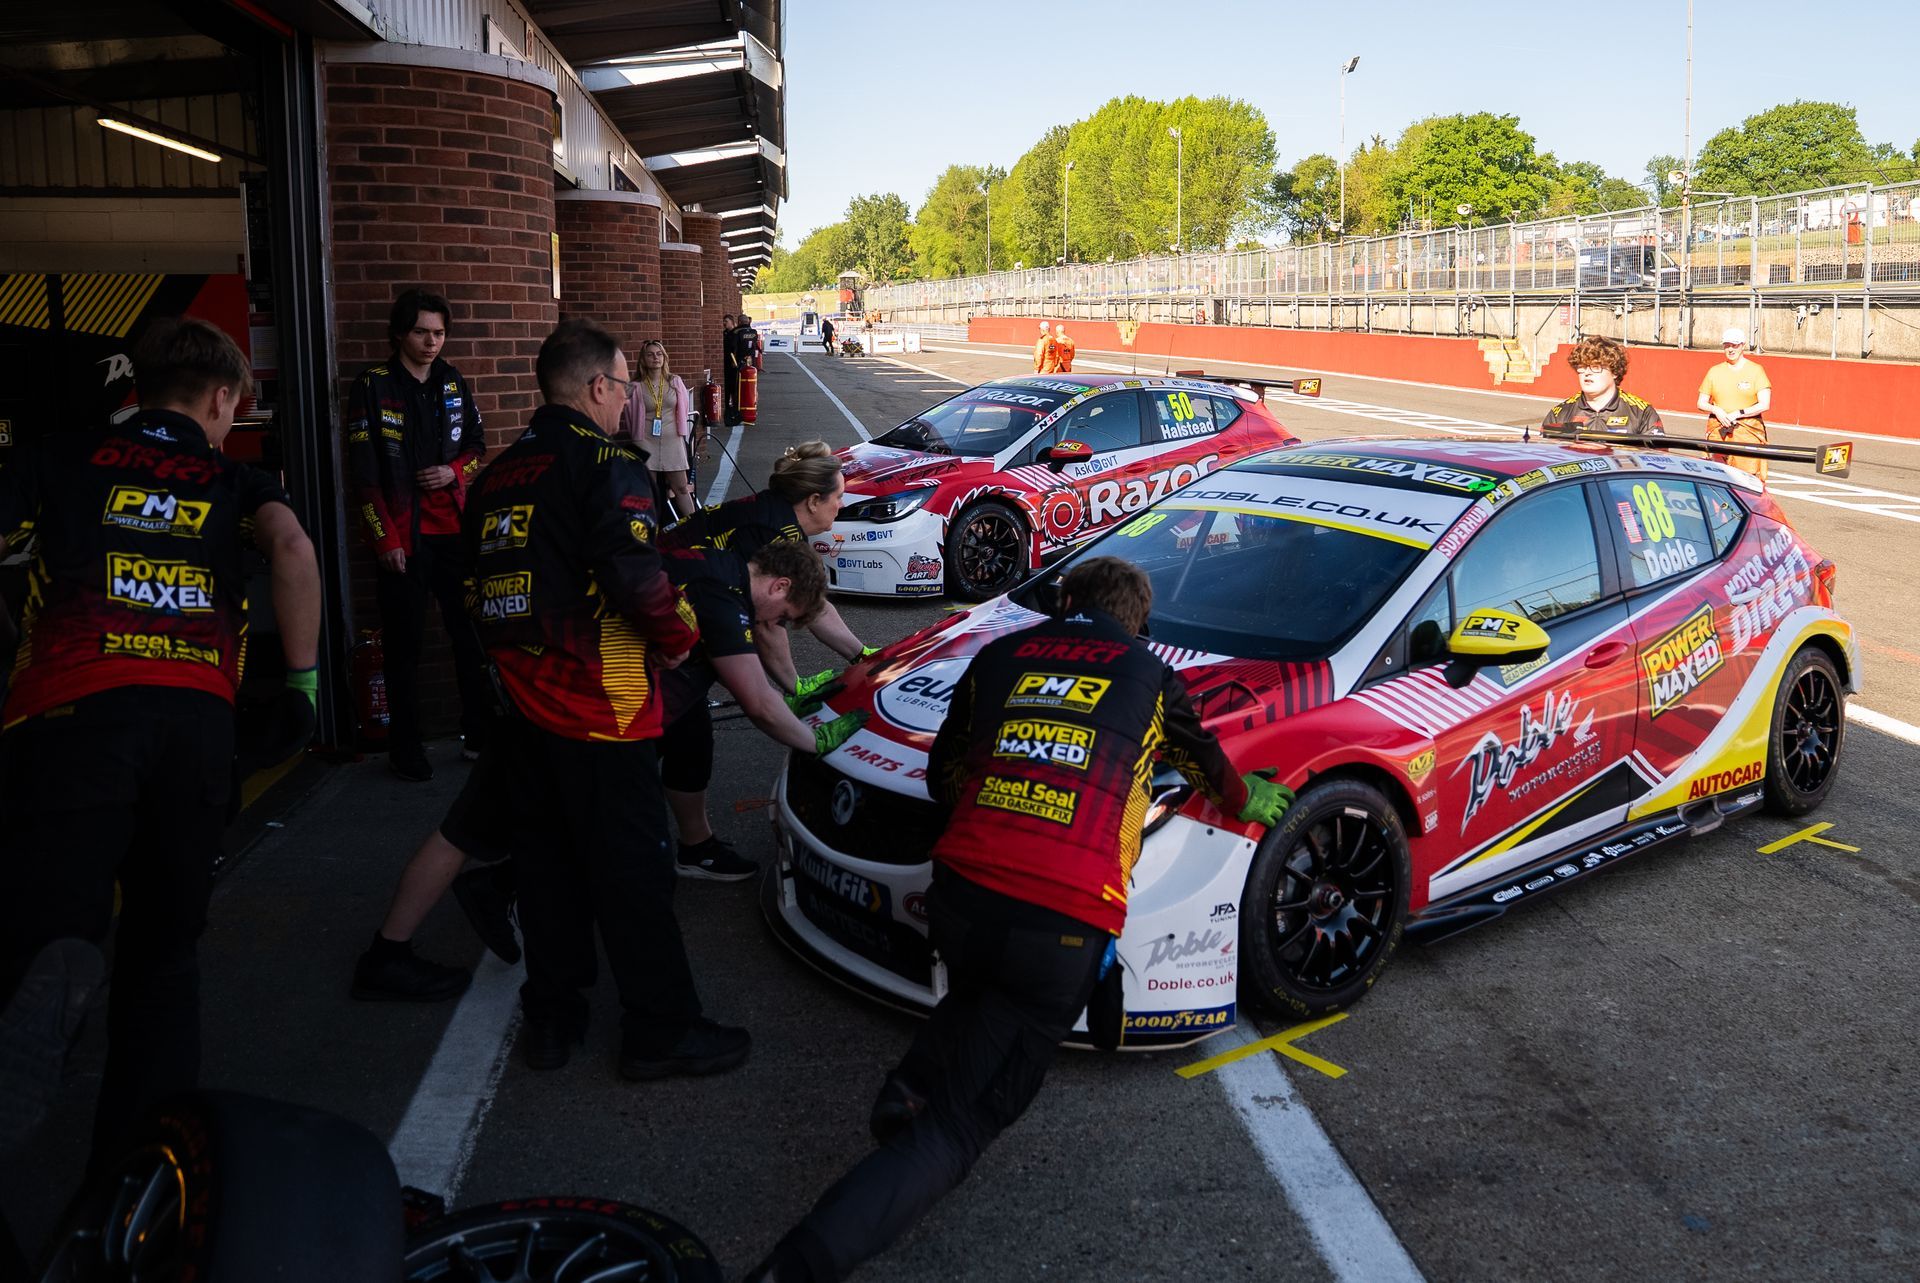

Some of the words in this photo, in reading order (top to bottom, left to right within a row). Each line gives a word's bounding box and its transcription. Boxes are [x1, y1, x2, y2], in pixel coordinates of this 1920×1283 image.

[980, 390, 1054, 407] Razor
[1168, 392, 1194, 421] 50
[1160, 418, 1215, 439] Halstead
[1075, 464, 1091, 477] Ask
[1101, 455, 1118, 471] GVT
[1260, 453, 1360, 469] POWER
[1354, 458, 1480, 487] MAXED
[1553, 464, 1581, 476] POWER
[1580, 457, 1609, 472] MAXED
[1089, 455, 1219, 524] Razor
[1485, 484, 1511, 504] PMR
[482, 511, 529, 539] PMR
[1117, 511, 1168, 539] 88
[1174, 490, 1445, 534] DOBLE.CO.UK
[1632, 481, 1676, 543] 88
[851, 532, 866, 542] Ask
[877, 530, 894, 540] GVT
[1180, 533, 1227, 549] AUCAR
[1439, 504, 1489, 558] SUPERHUB
[1642, 538, 1698, 580] Doble
[1723, 554, 1769, 600] MOTOR
[1763, 524, 1793, 566] PARTS
[113, 557, 208, 593] POWER
[1729, 543, 1812, 657] DIRECT
[1465, 616, 1521, 634] PMR
[104, 632, 173, 650] Steel
[1014, 642, 1130, 664] DIRECT
[1647, 614, 1712, 684] POWER
[1653, 639, 1719, 709] MAXED
[1015, 677, 1102, 699] PMR
[1036, 698, 1062, 706] MAXED
[1002, 723, 1089, 748] POWER
[844, 745, 904, 772] PARTS
[998, 739, 1086, 764] MAXED
[1450, 689, 1580, 837] Doble
[983, 776, 1030, 799] Steel
[1031, 783, 1076, 810] Seal
[1688, 761, 1763, 800] AUTOCAR
[978, 793, 1007, 806] HEAD
[1007, 797, 1050, 817] GASKET
[1051, 805, 1071, 823] FIX
[1209, 902, 1237, 917] JFA
[1136, 928, 1227, 974] Doble
[1176, 955, 1236, 970] MOTORCYCLES
[1147, 971, 1235, 991] Doble.co.uk
[1124, 1010, 1228, 1030] GOODYEAR
